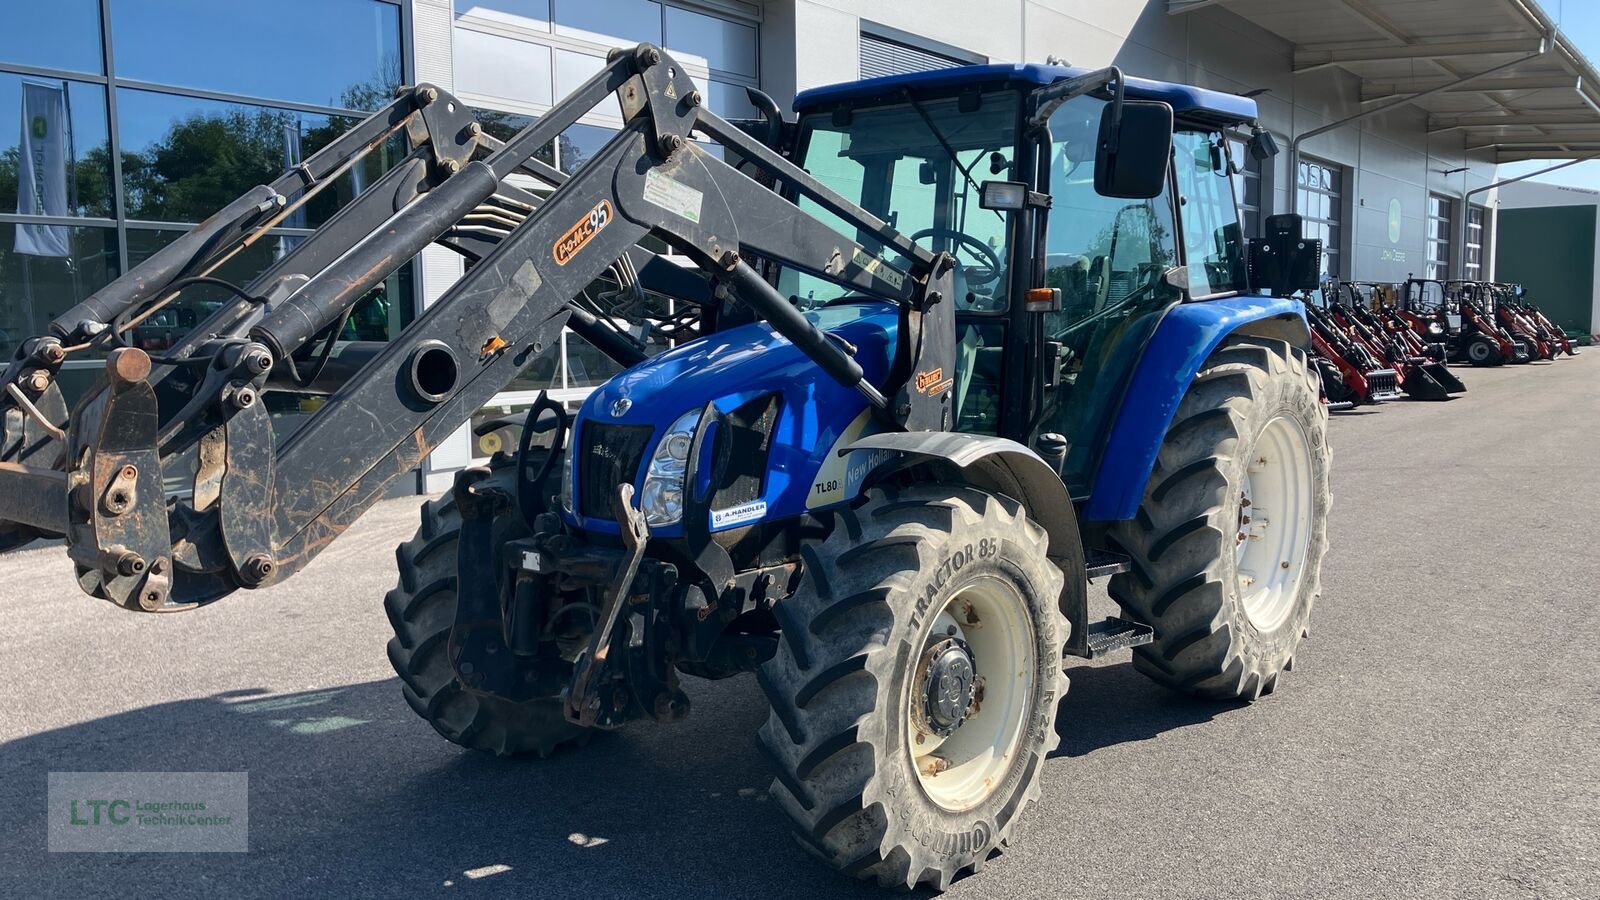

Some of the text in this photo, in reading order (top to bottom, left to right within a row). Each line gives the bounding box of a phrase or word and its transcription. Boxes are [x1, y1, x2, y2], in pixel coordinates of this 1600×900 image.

[847, 461, 867, 486] New
[907, 538, 997, 630] TRACTOR 85
[1043, 690, 1056, 705] R
